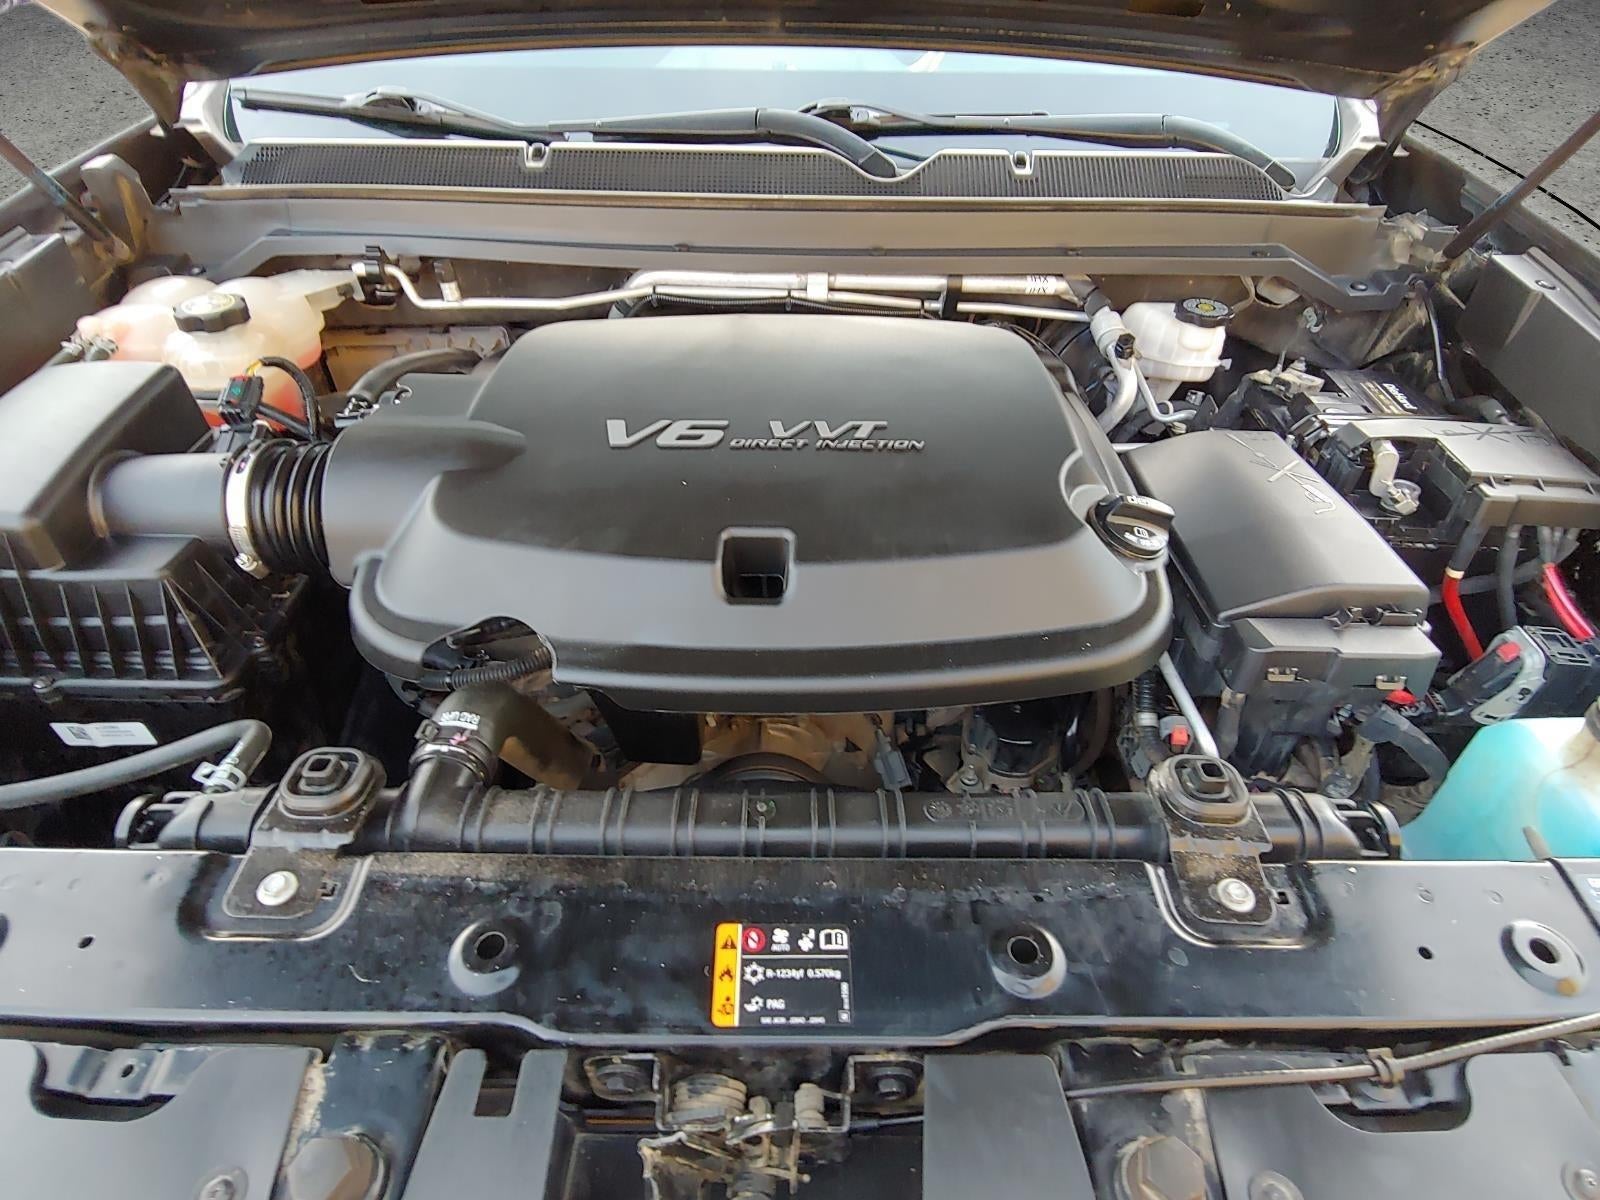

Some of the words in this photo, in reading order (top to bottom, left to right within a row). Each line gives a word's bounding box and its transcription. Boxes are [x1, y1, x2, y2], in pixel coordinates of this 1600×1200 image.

[606, 419, 729, 448] V6
[769, 420, 888, 439] VVT
[729, 438, 809, 449] DIRECT
[815, 439, 925, 450] INJECTION
[765, 998, 786, 1010] PAG
